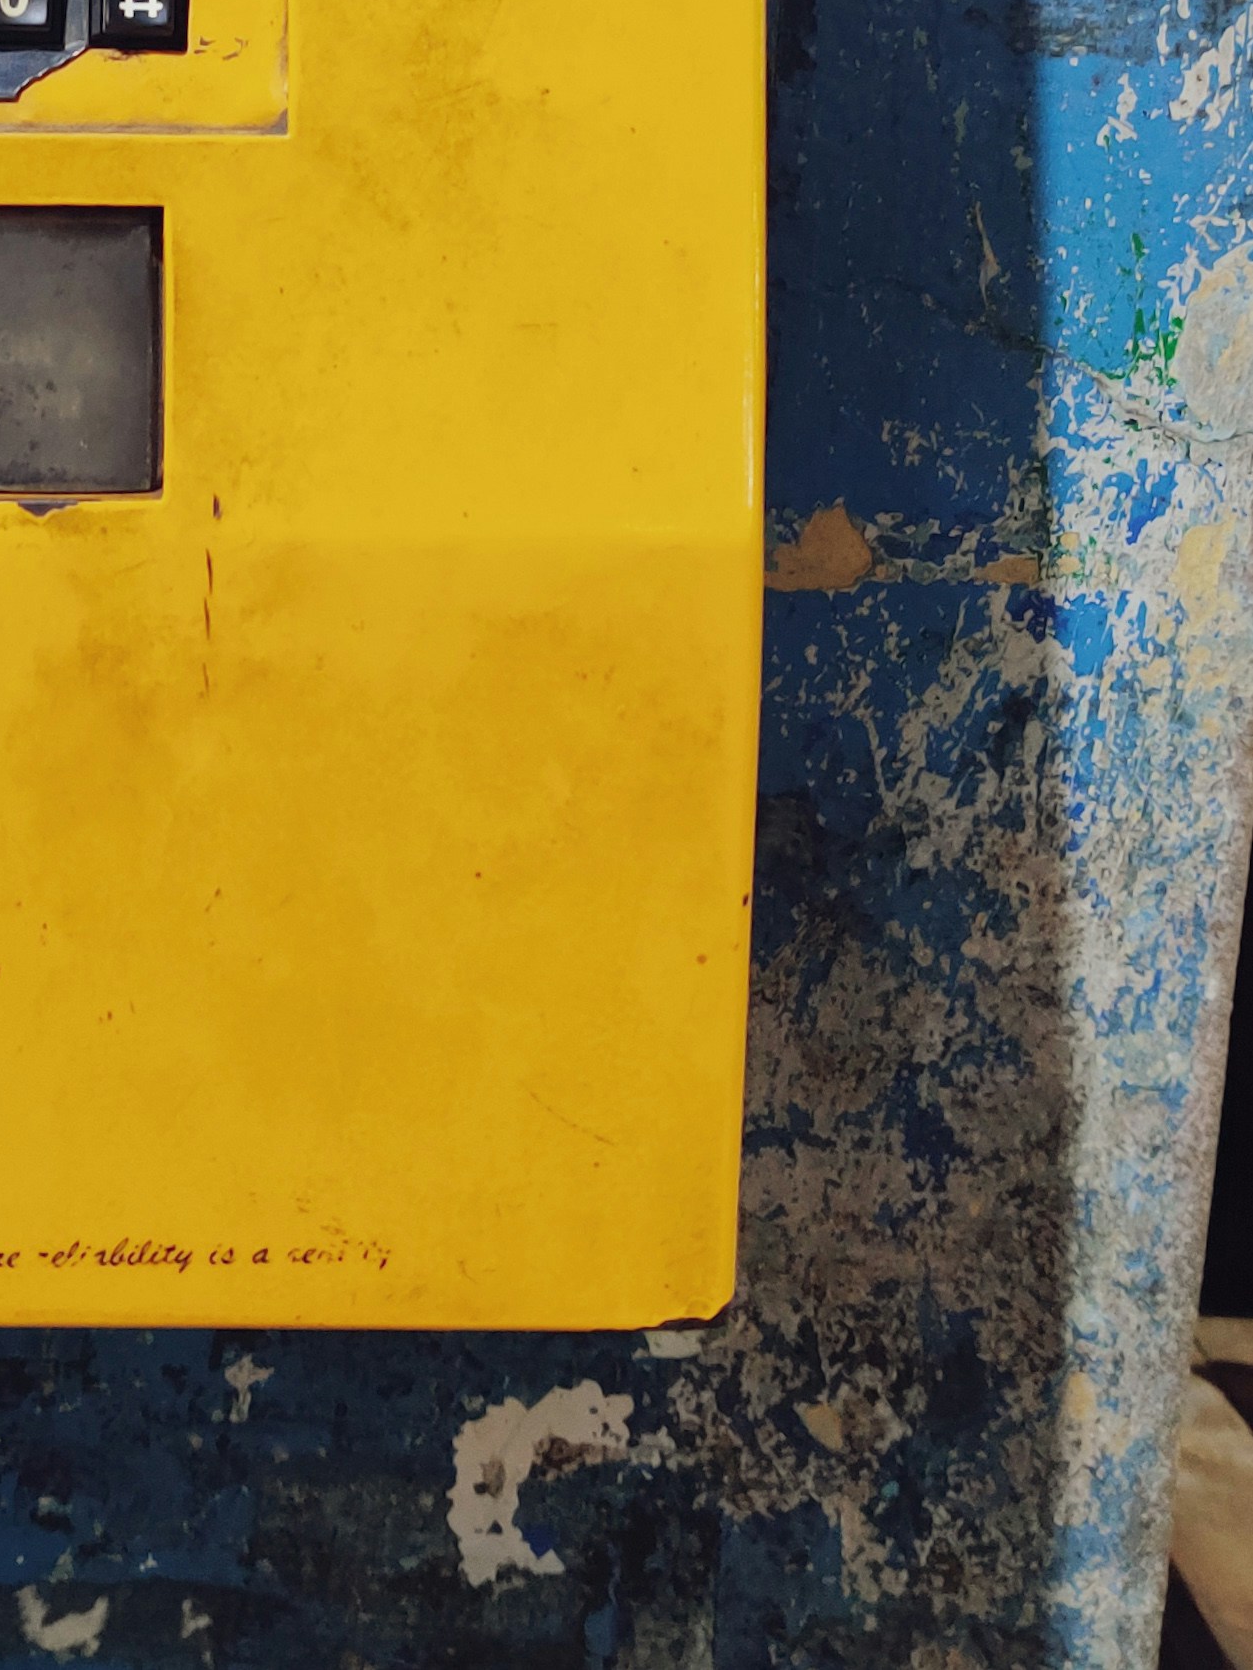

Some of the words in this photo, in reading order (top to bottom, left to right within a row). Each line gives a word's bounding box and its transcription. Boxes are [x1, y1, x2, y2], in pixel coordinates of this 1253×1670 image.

[38, 1237, 193, 1274] eliability
[209, 1243, 235, 1265] is
[251, 1247, 269, 1264] a
